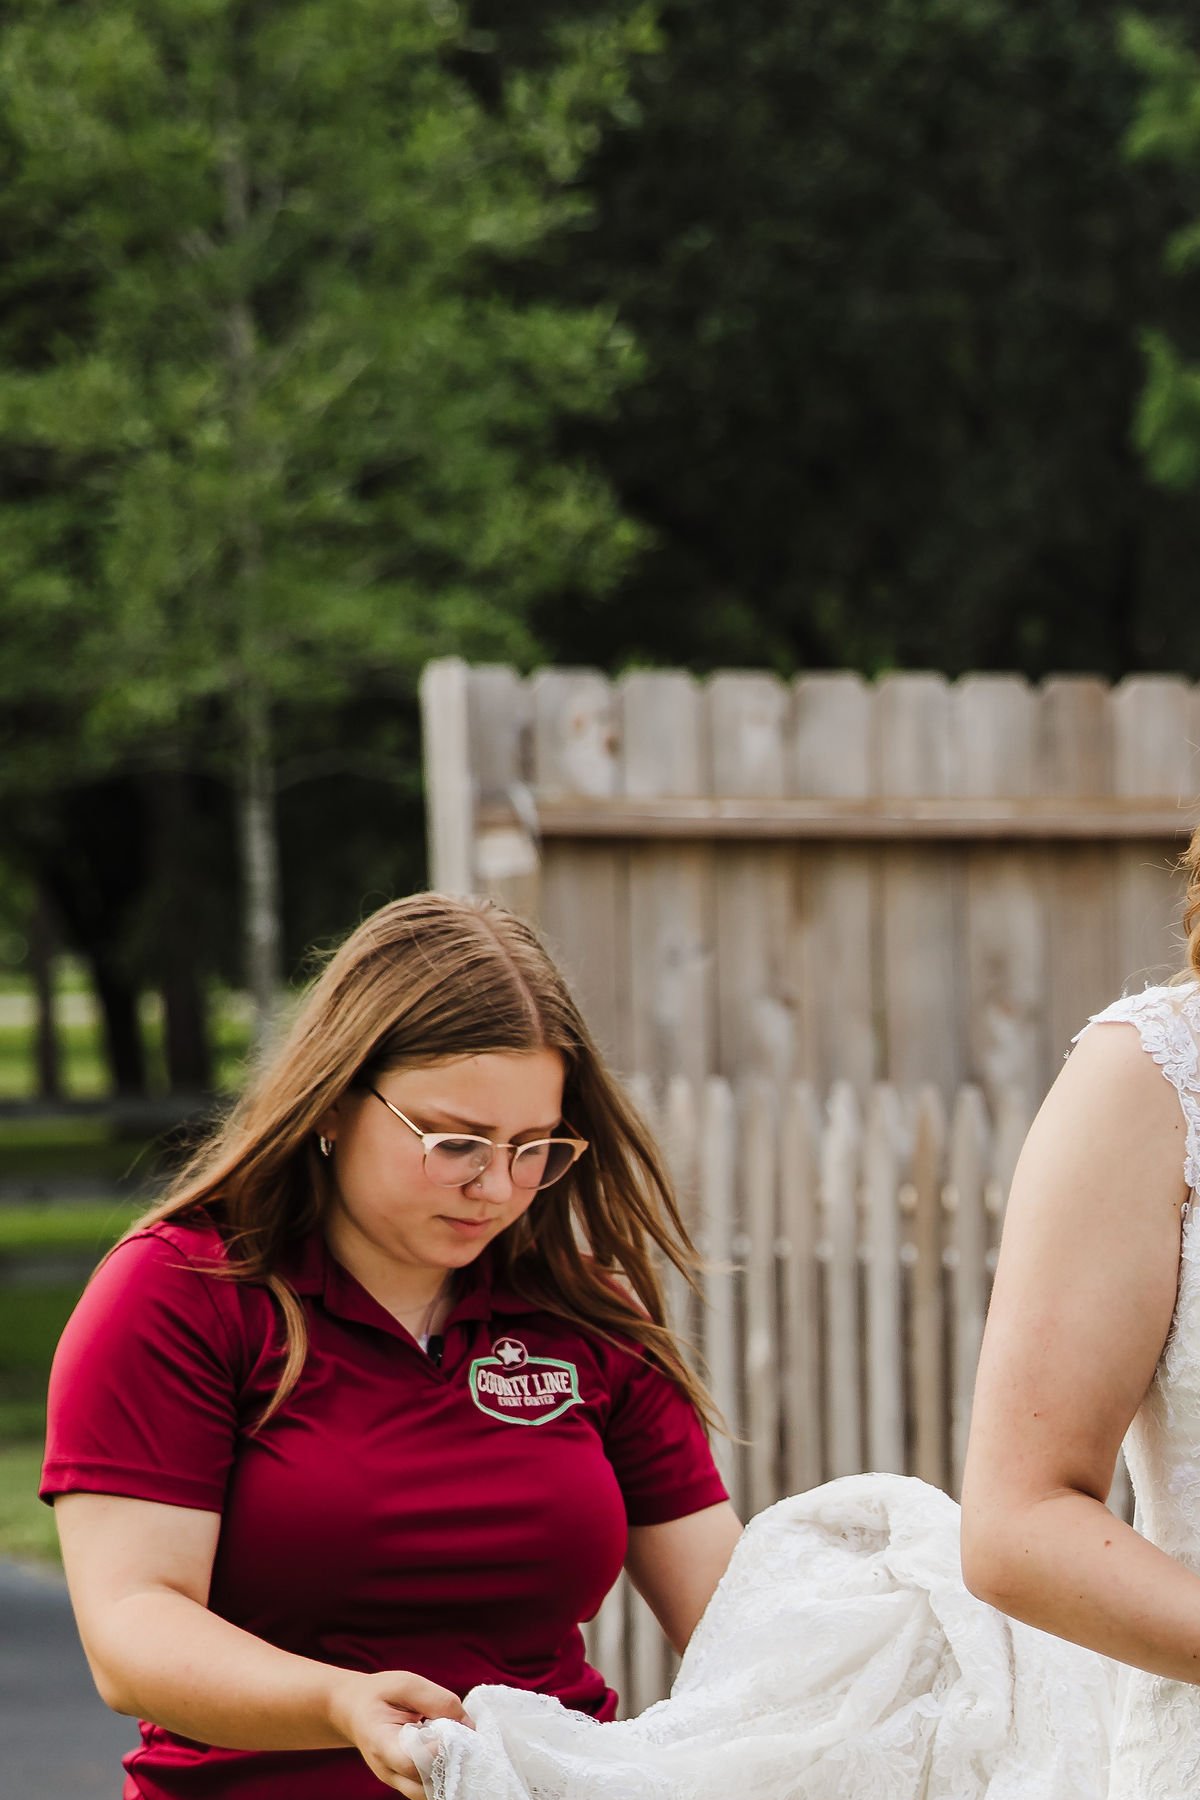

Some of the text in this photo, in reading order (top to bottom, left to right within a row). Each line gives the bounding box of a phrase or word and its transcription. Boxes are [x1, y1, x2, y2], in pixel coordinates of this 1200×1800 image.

[477, 1369, 572, 1396] COUNTY LINE
[498, 1395, 556, 1406] EVENT CENTER
